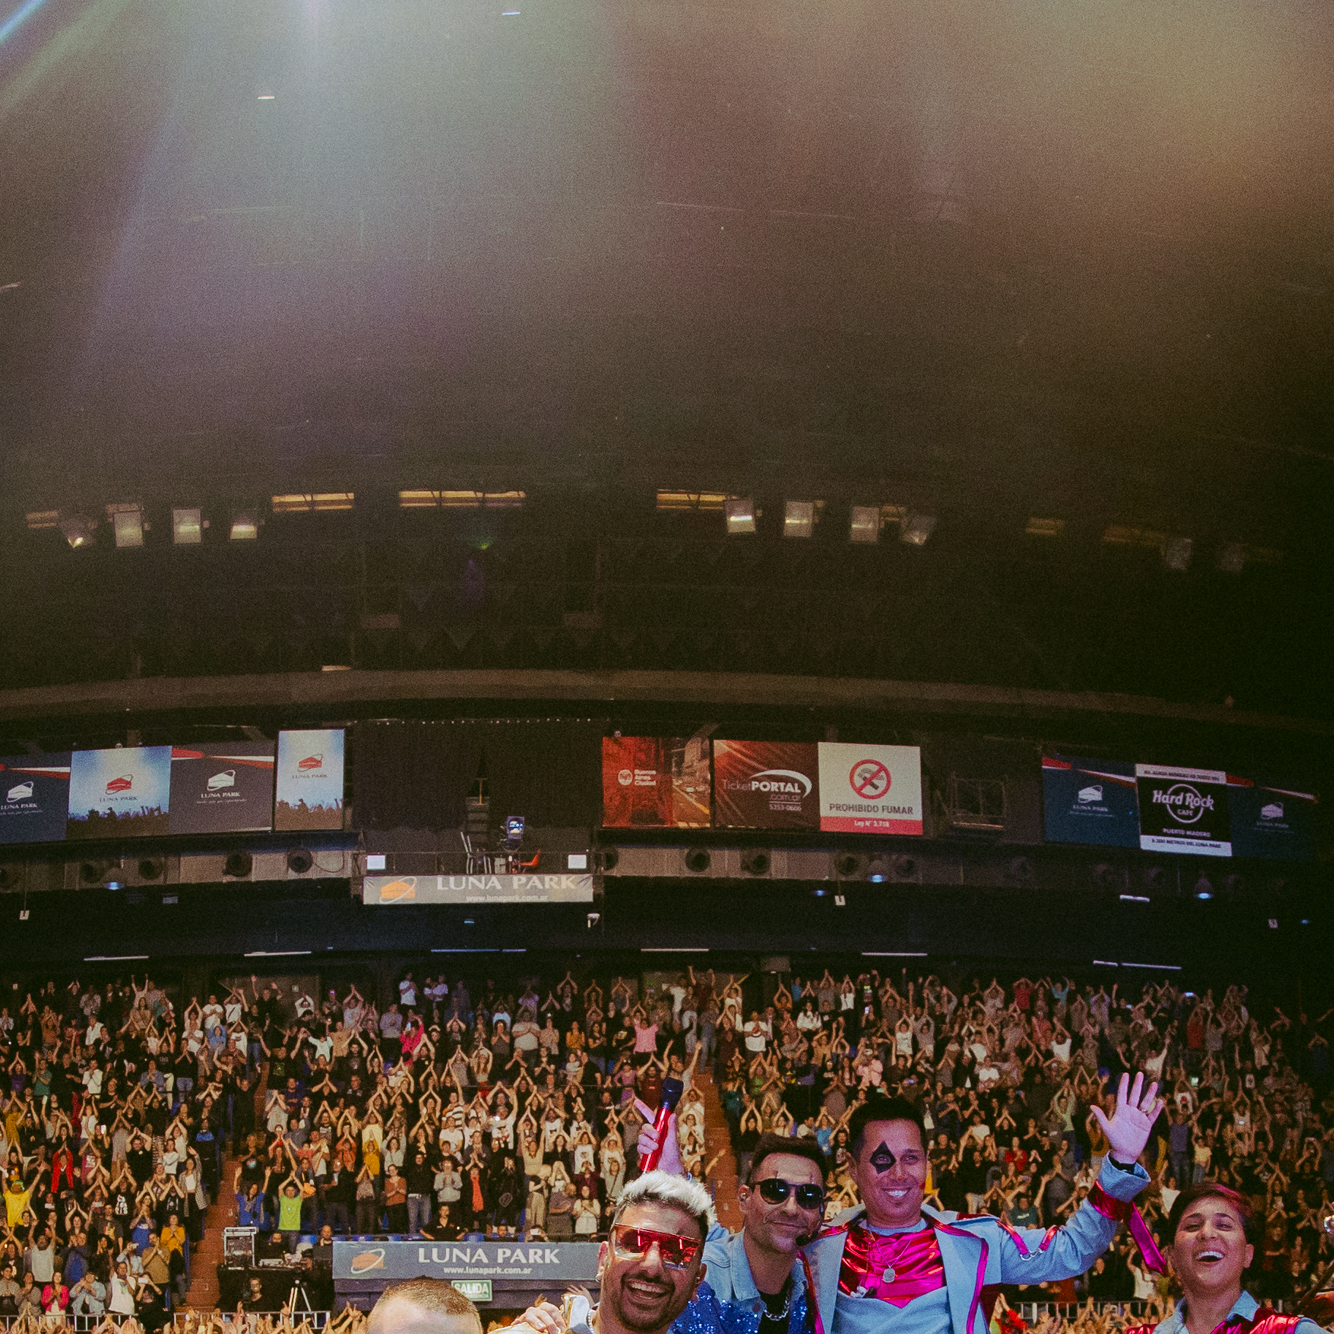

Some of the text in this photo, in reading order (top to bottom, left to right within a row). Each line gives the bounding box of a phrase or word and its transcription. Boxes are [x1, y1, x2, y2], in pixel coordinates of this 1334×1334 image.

[1152, 789, 1215, 811] Hard Rock
[829, 803, 913, 815] PROHIBIDO FUMAR
[437, 875, 579, 890] LUNA PARK
[418, 1247, 560, 1264] LUNA PARK
[443, 1266, 532, 1275] www.lunapark.com.ar
[454, 1282, 489, 1294] SALIDA
